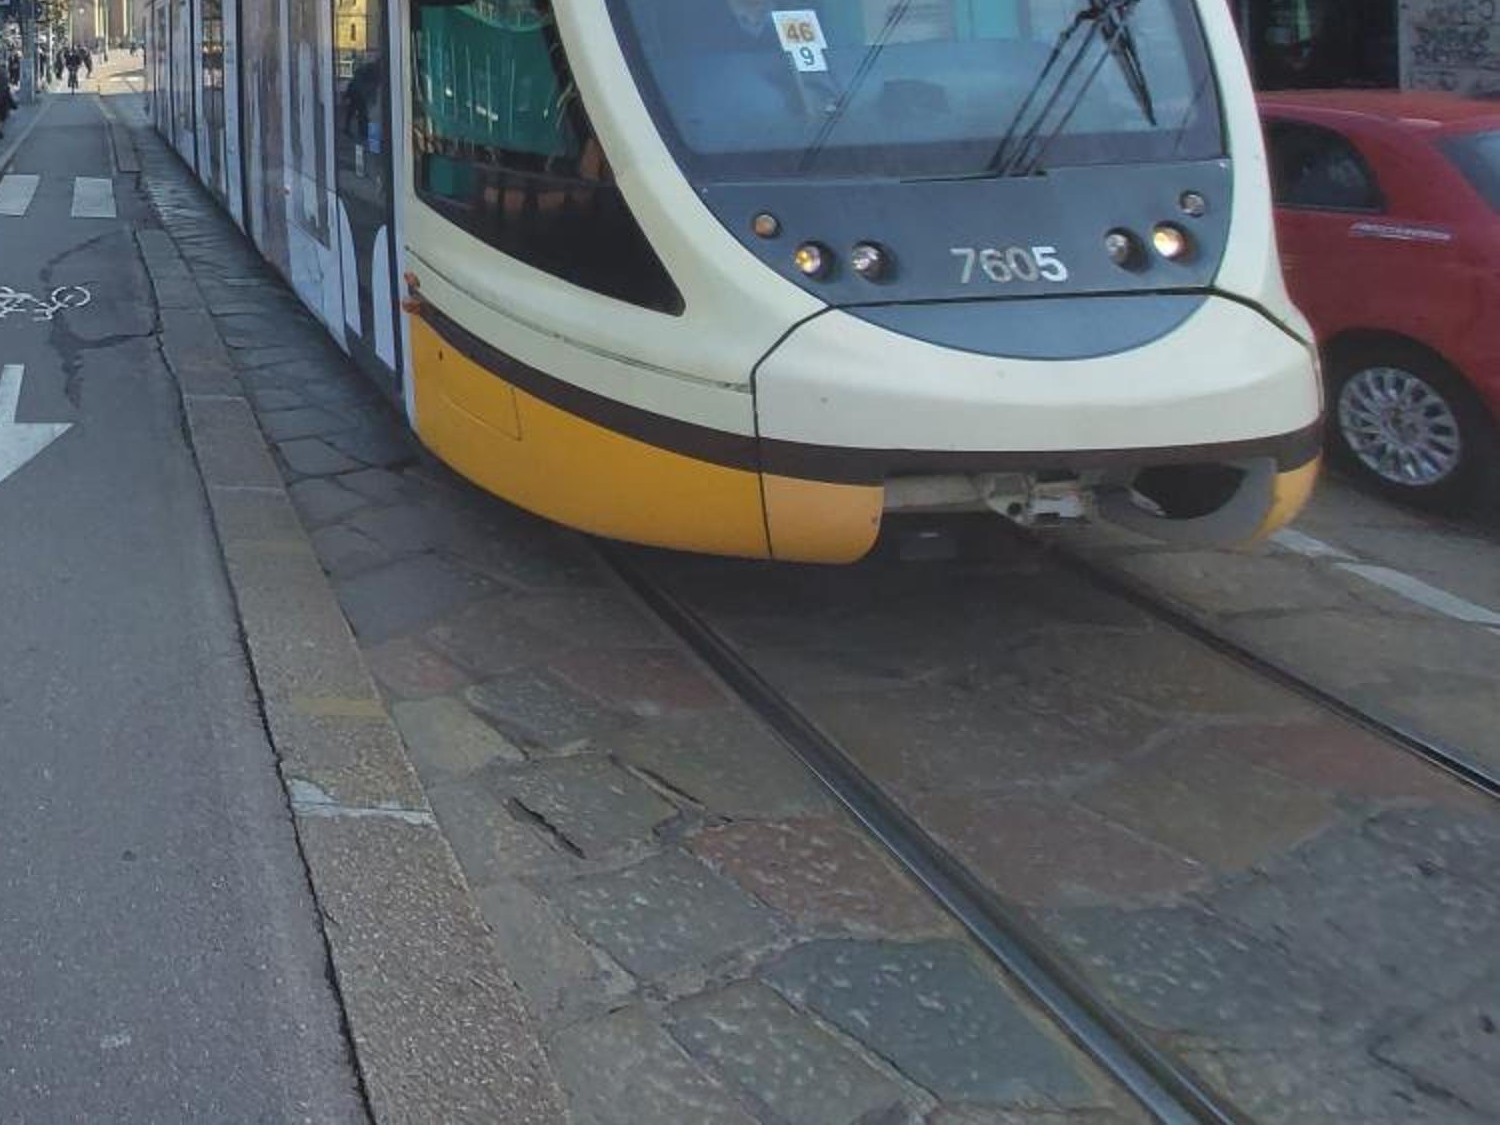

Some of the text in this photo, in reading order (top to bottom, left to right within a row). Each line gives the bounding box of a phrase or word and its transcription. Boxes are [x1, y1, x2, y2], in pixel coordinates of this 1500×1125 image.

[787, 22, 815, 42] 46
[800, 46, 815, 66] 9
[950, 246, 1068, 283] 7605
